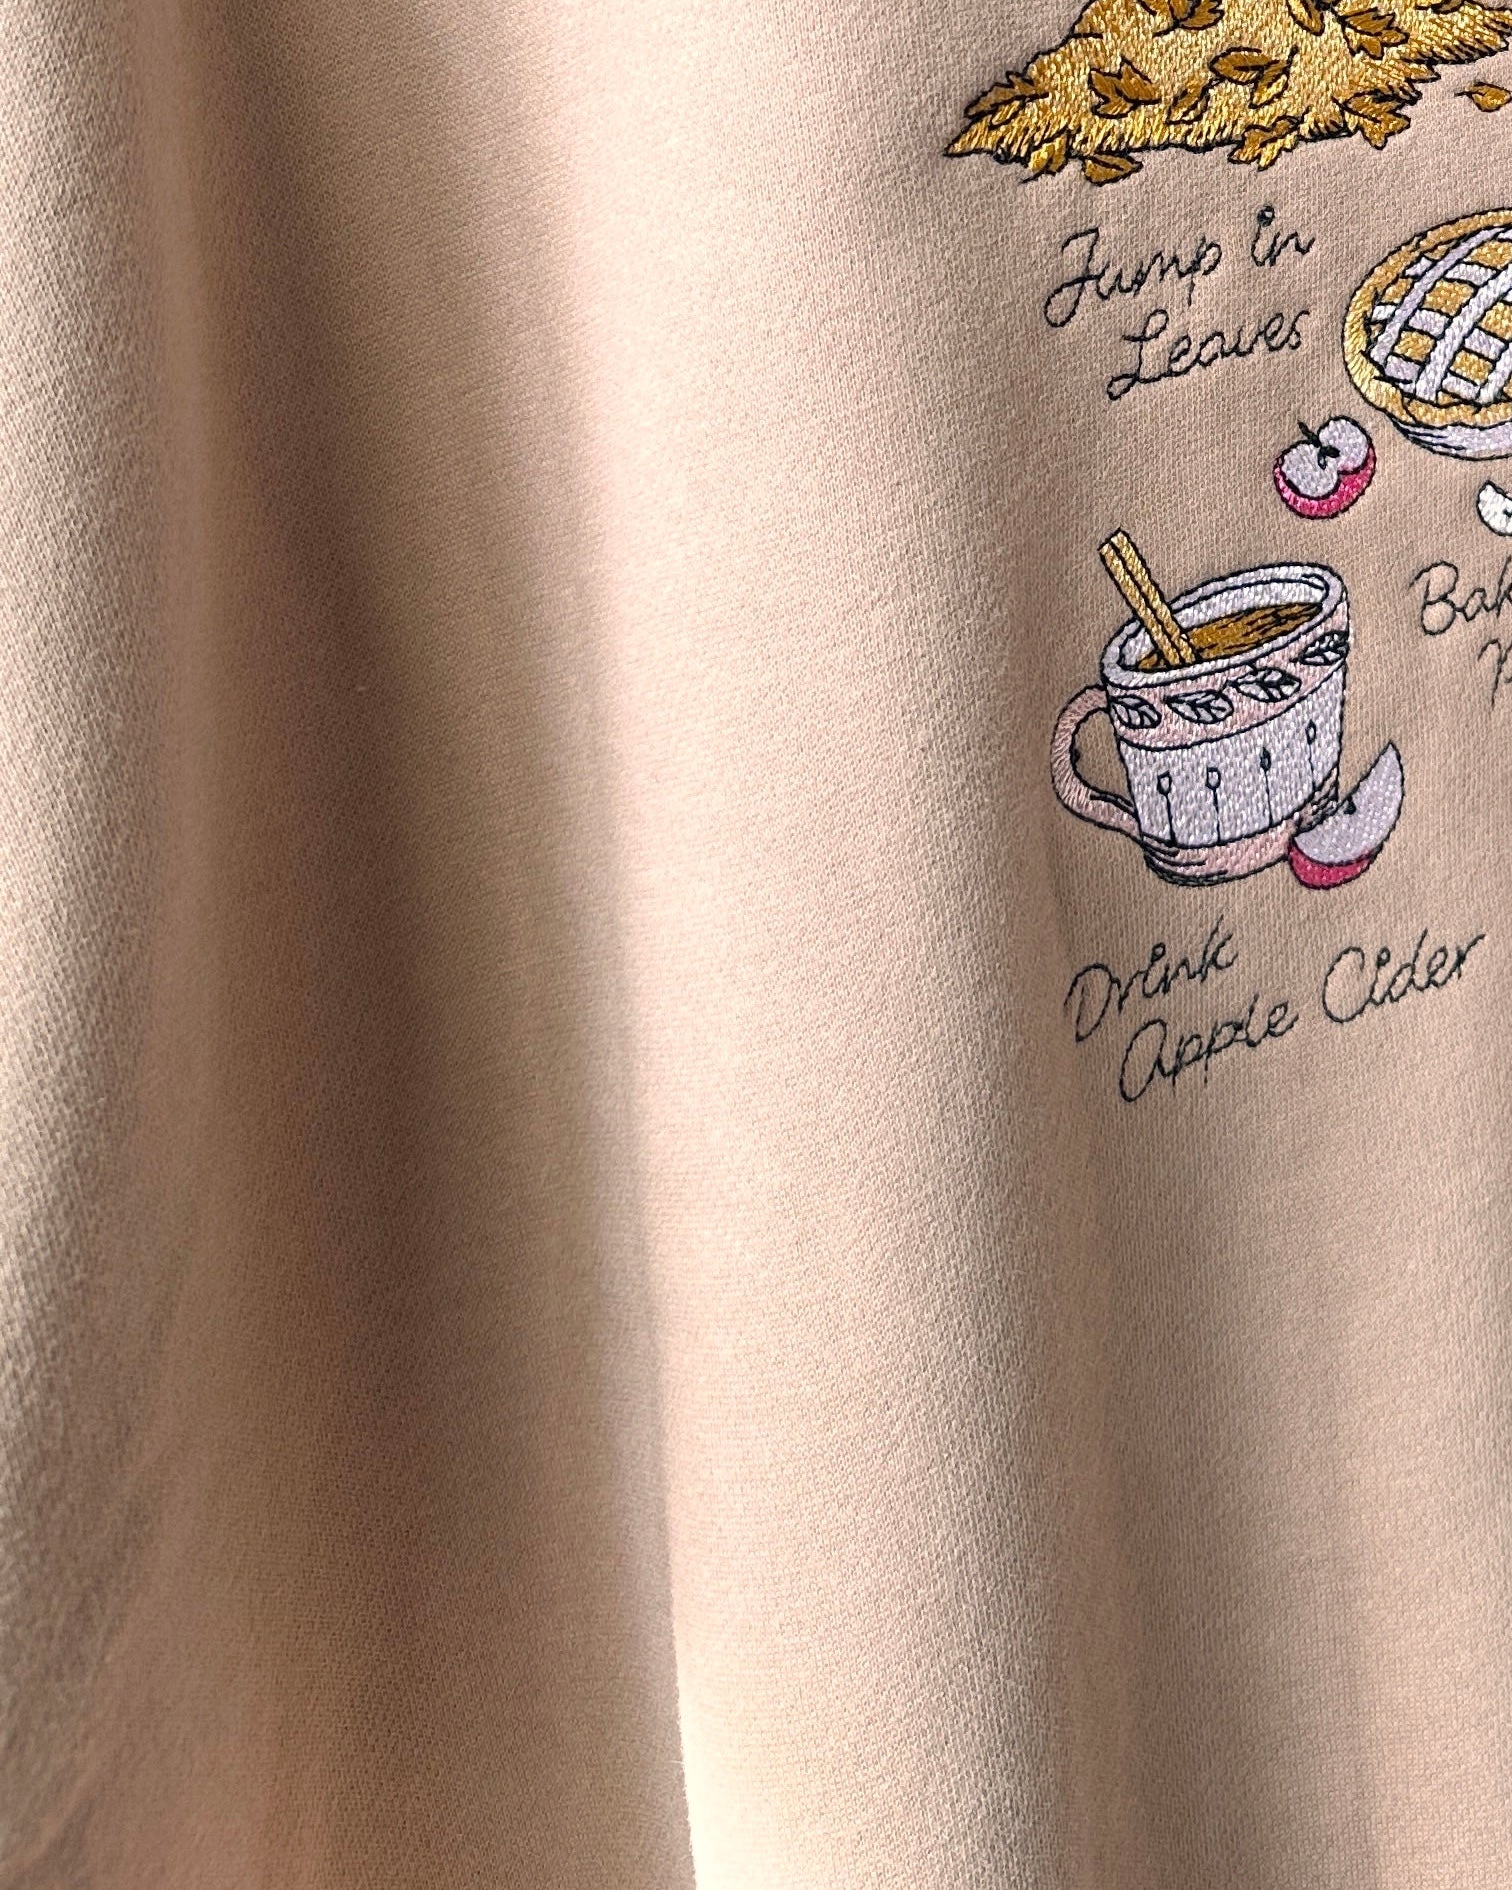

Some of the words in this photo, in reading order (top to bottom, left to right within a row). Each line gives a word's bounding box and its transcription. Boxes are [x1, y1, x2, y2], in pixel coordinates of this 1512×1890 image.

[1043, 227, 1223, 328] Jump
[1250, 205, 1315, 267] in
[1105, 308, 1311, 401] Leaves
[1062, 914, 1239, 1043] Drink
[1118, 993, 1300, 1104] Apple
[1321, 927, 1487, 1024] Cider
